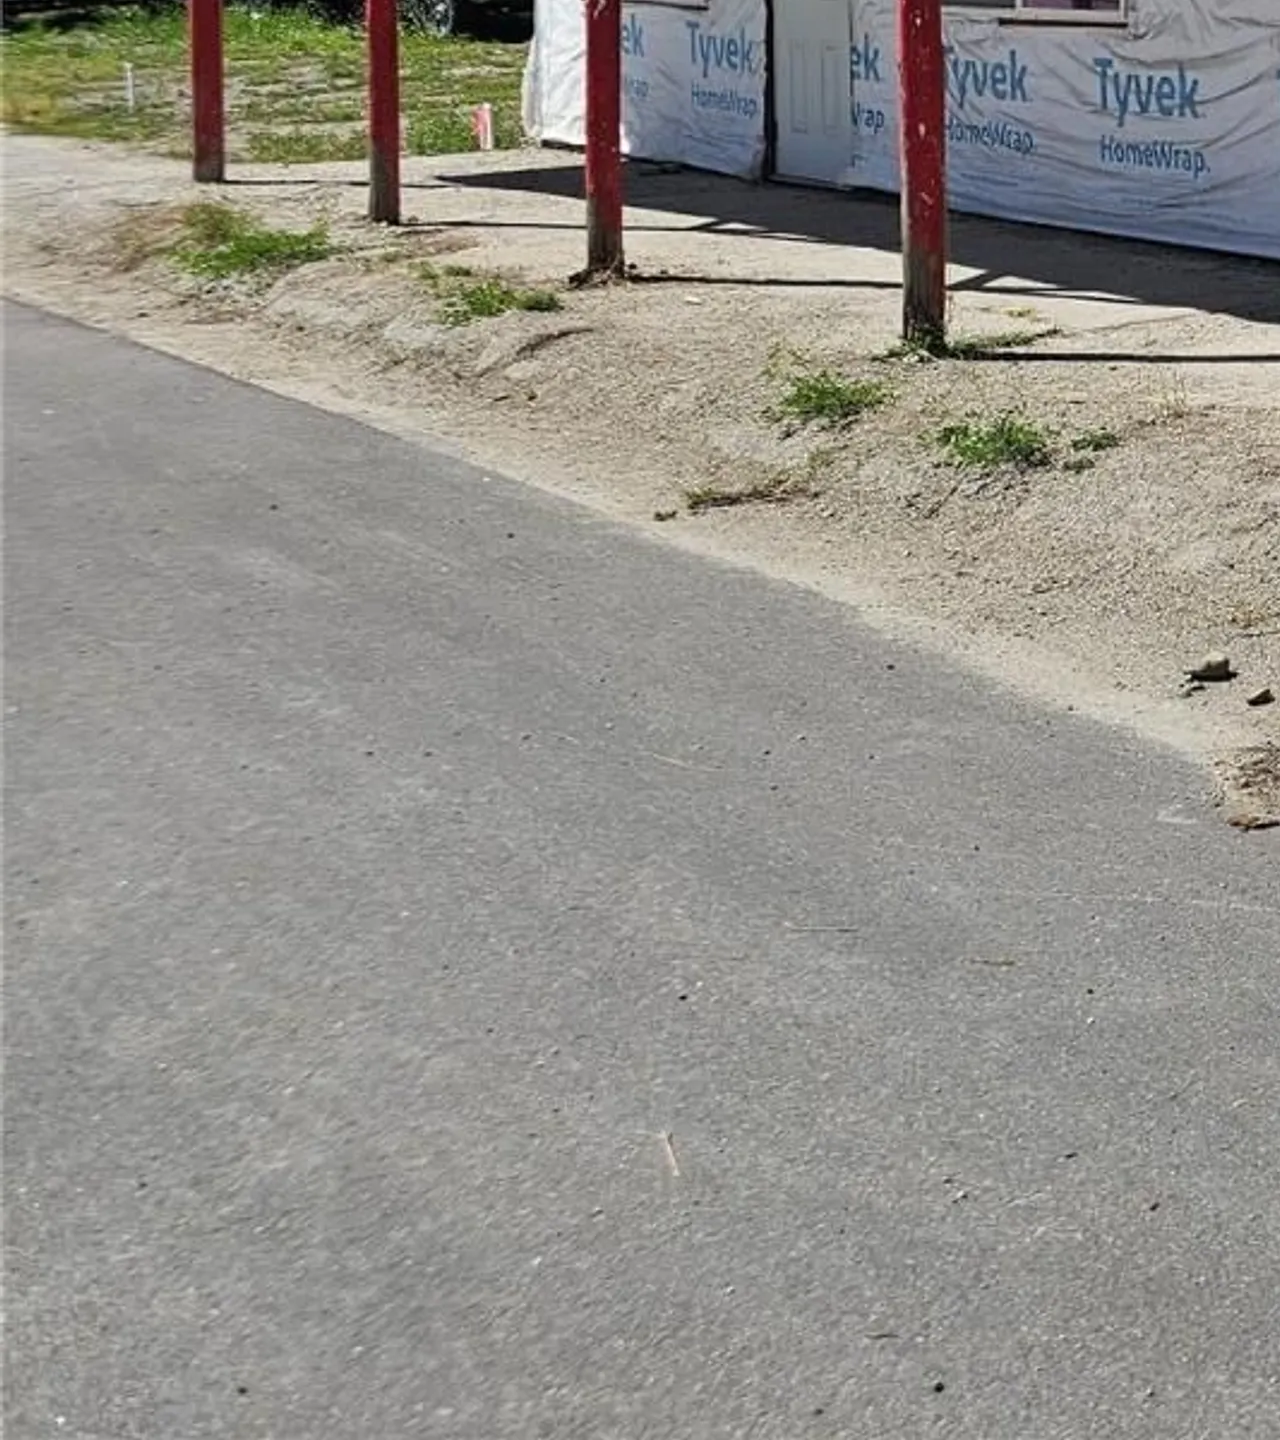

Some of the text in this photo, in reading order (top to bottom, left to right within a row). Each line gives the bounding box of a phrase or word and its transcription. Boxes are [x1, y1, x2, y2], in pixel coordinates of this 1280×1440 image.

[943, 47, 1027, 109] yvek
[1093, 57, 1200, 128] Tyvek
[1101, 134, 1204, 180] HomeWrap
